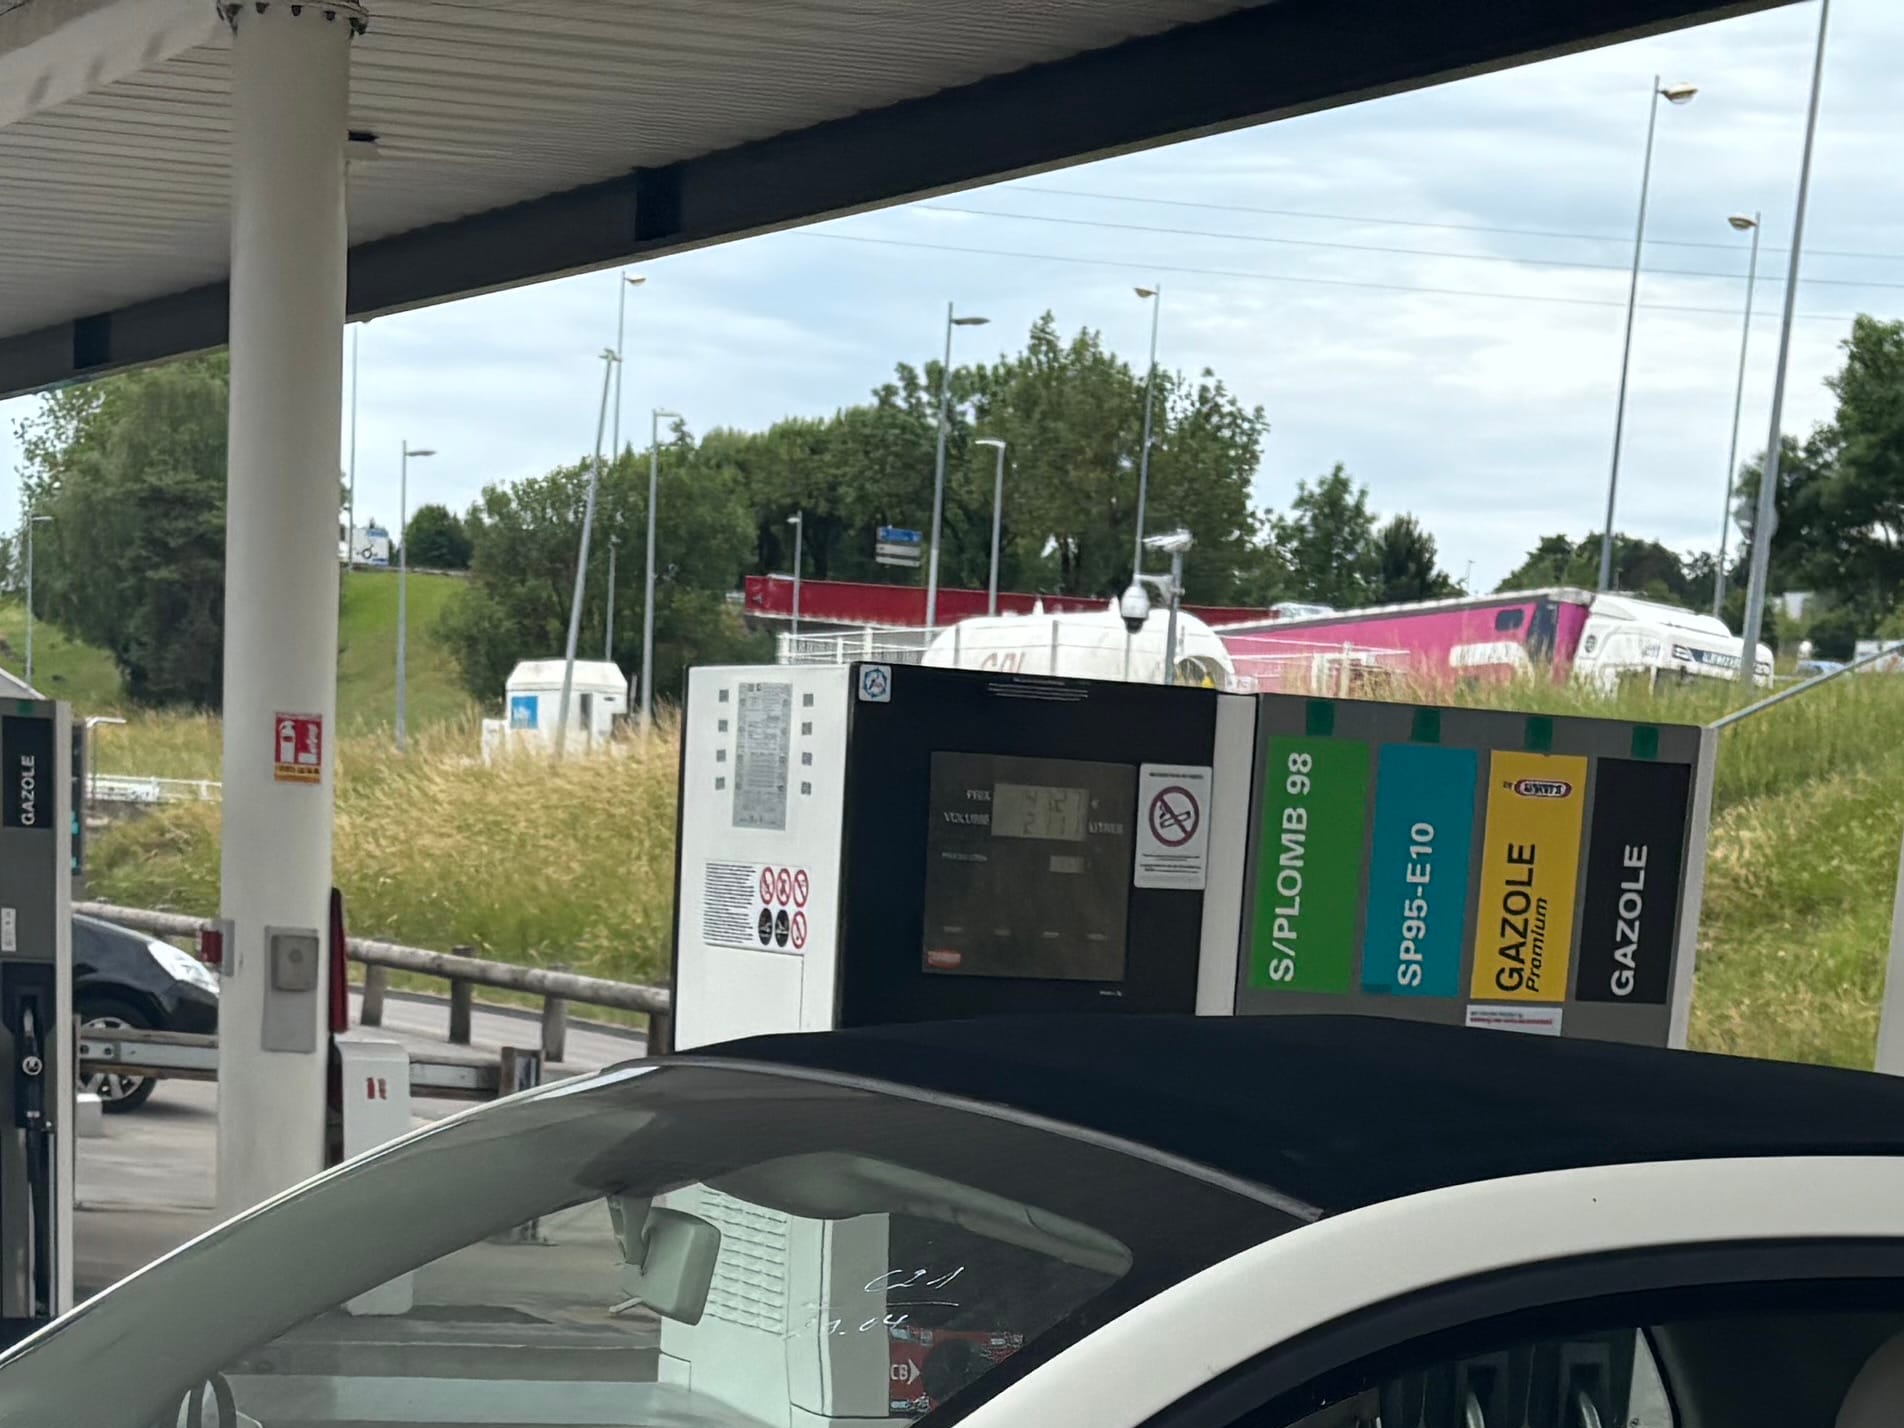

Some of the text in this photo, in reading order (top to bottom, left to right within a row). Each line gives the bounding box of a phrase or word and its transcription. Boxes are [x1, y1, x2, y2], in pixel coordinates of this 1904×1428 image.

[21, 755, 35, 825] GAZOLE
[1269, 752, 1312, 982] S/PLOMB 98
[1397, 822, 1435, 987] SP95-E10
[1496, 843, 1536, 992] GAZOLE
[1610, 844, 1648, 996] GAZOLE
[1525, 897, 1548, 993] Premium
[890, 1363, 908, 1381] CB
